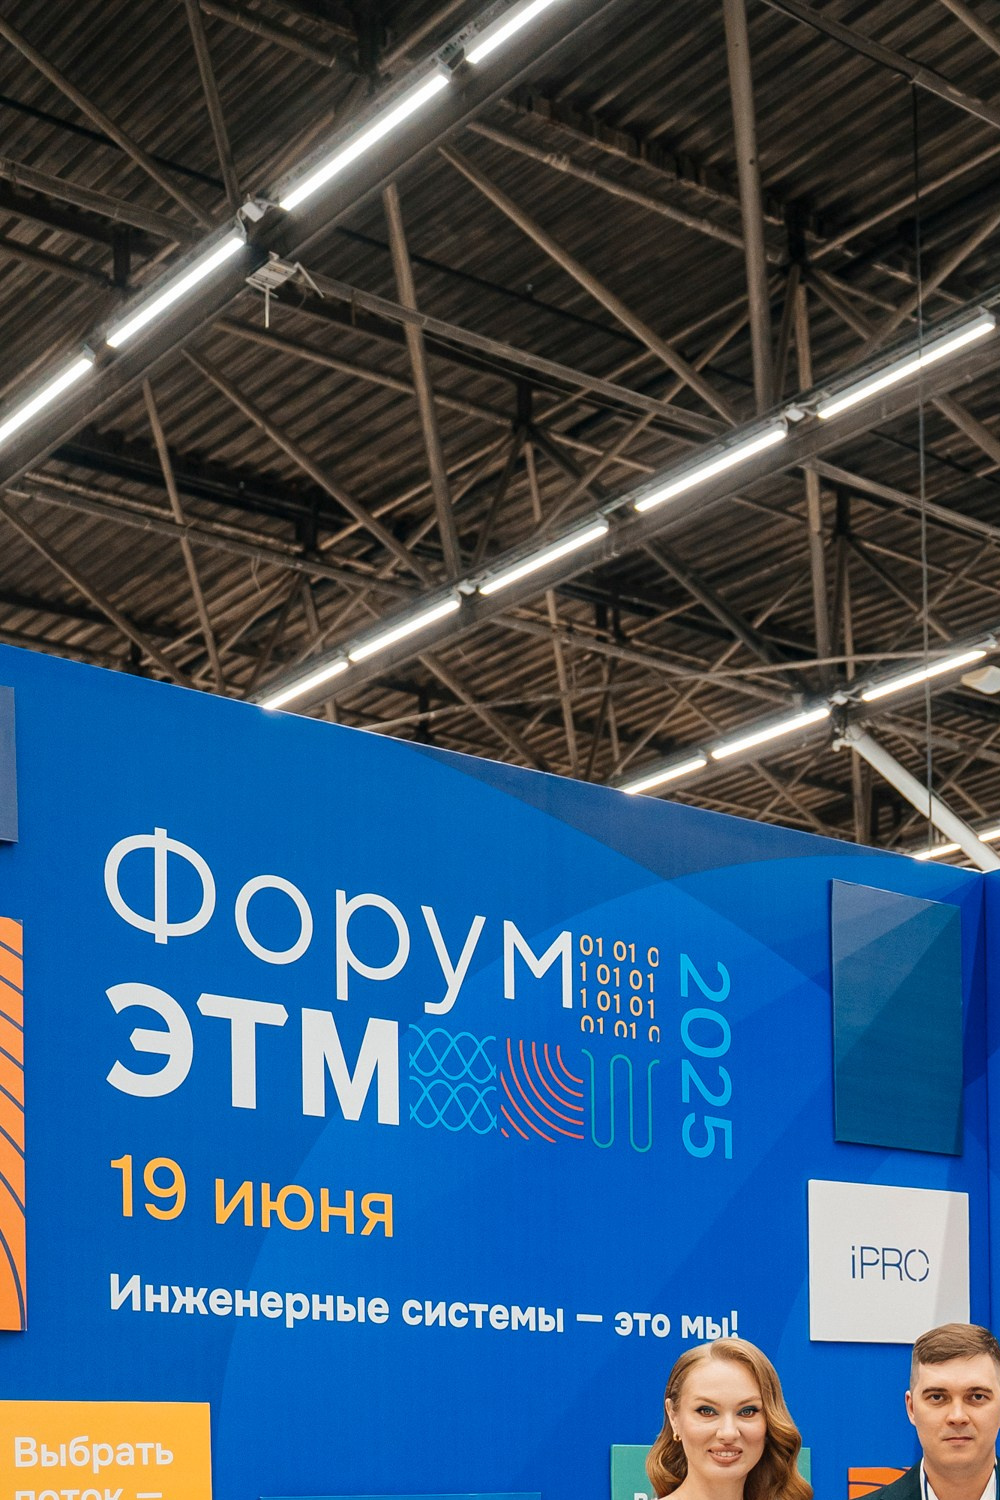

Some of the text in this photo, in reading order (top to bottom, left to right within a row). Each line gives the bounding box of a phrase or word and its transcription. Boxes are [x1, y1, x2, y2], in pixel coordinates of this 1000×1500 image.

[105, 828, 572, 1014] Форум
[106, 979, 399, 1126] ЭТМ
[680, 954, 732, 1158] 2025
[111, 1155, 393, 1237] 19 июня
[851, 1245, 929, 1282] iPRO
[110, 1274, 389, 1328] Инженерные
[402, 1299, 563, 1332] системы
[614, 1312, 670, 1339] это
[681, 1310, 739, 1338] мы!
[14, 1436, 174, 1473] Выбрать
